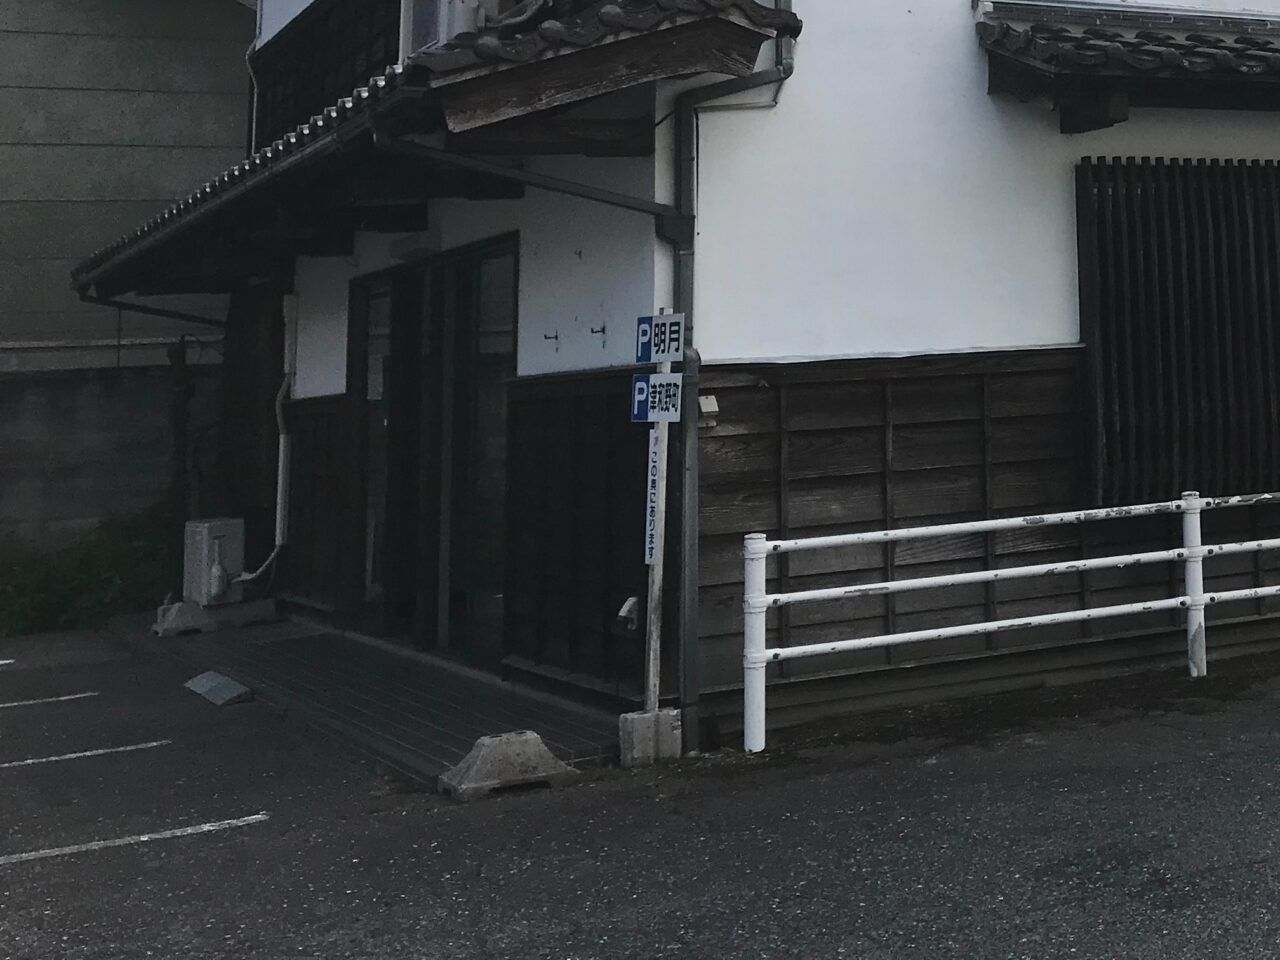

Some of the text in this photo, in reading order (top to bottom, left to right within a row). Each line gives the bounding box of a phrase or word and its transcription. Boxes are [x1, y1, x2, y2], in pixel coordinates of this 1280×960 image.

[638, 321, 681, 358] P 明月
[633, 381, 680, 415] P 津和野町
